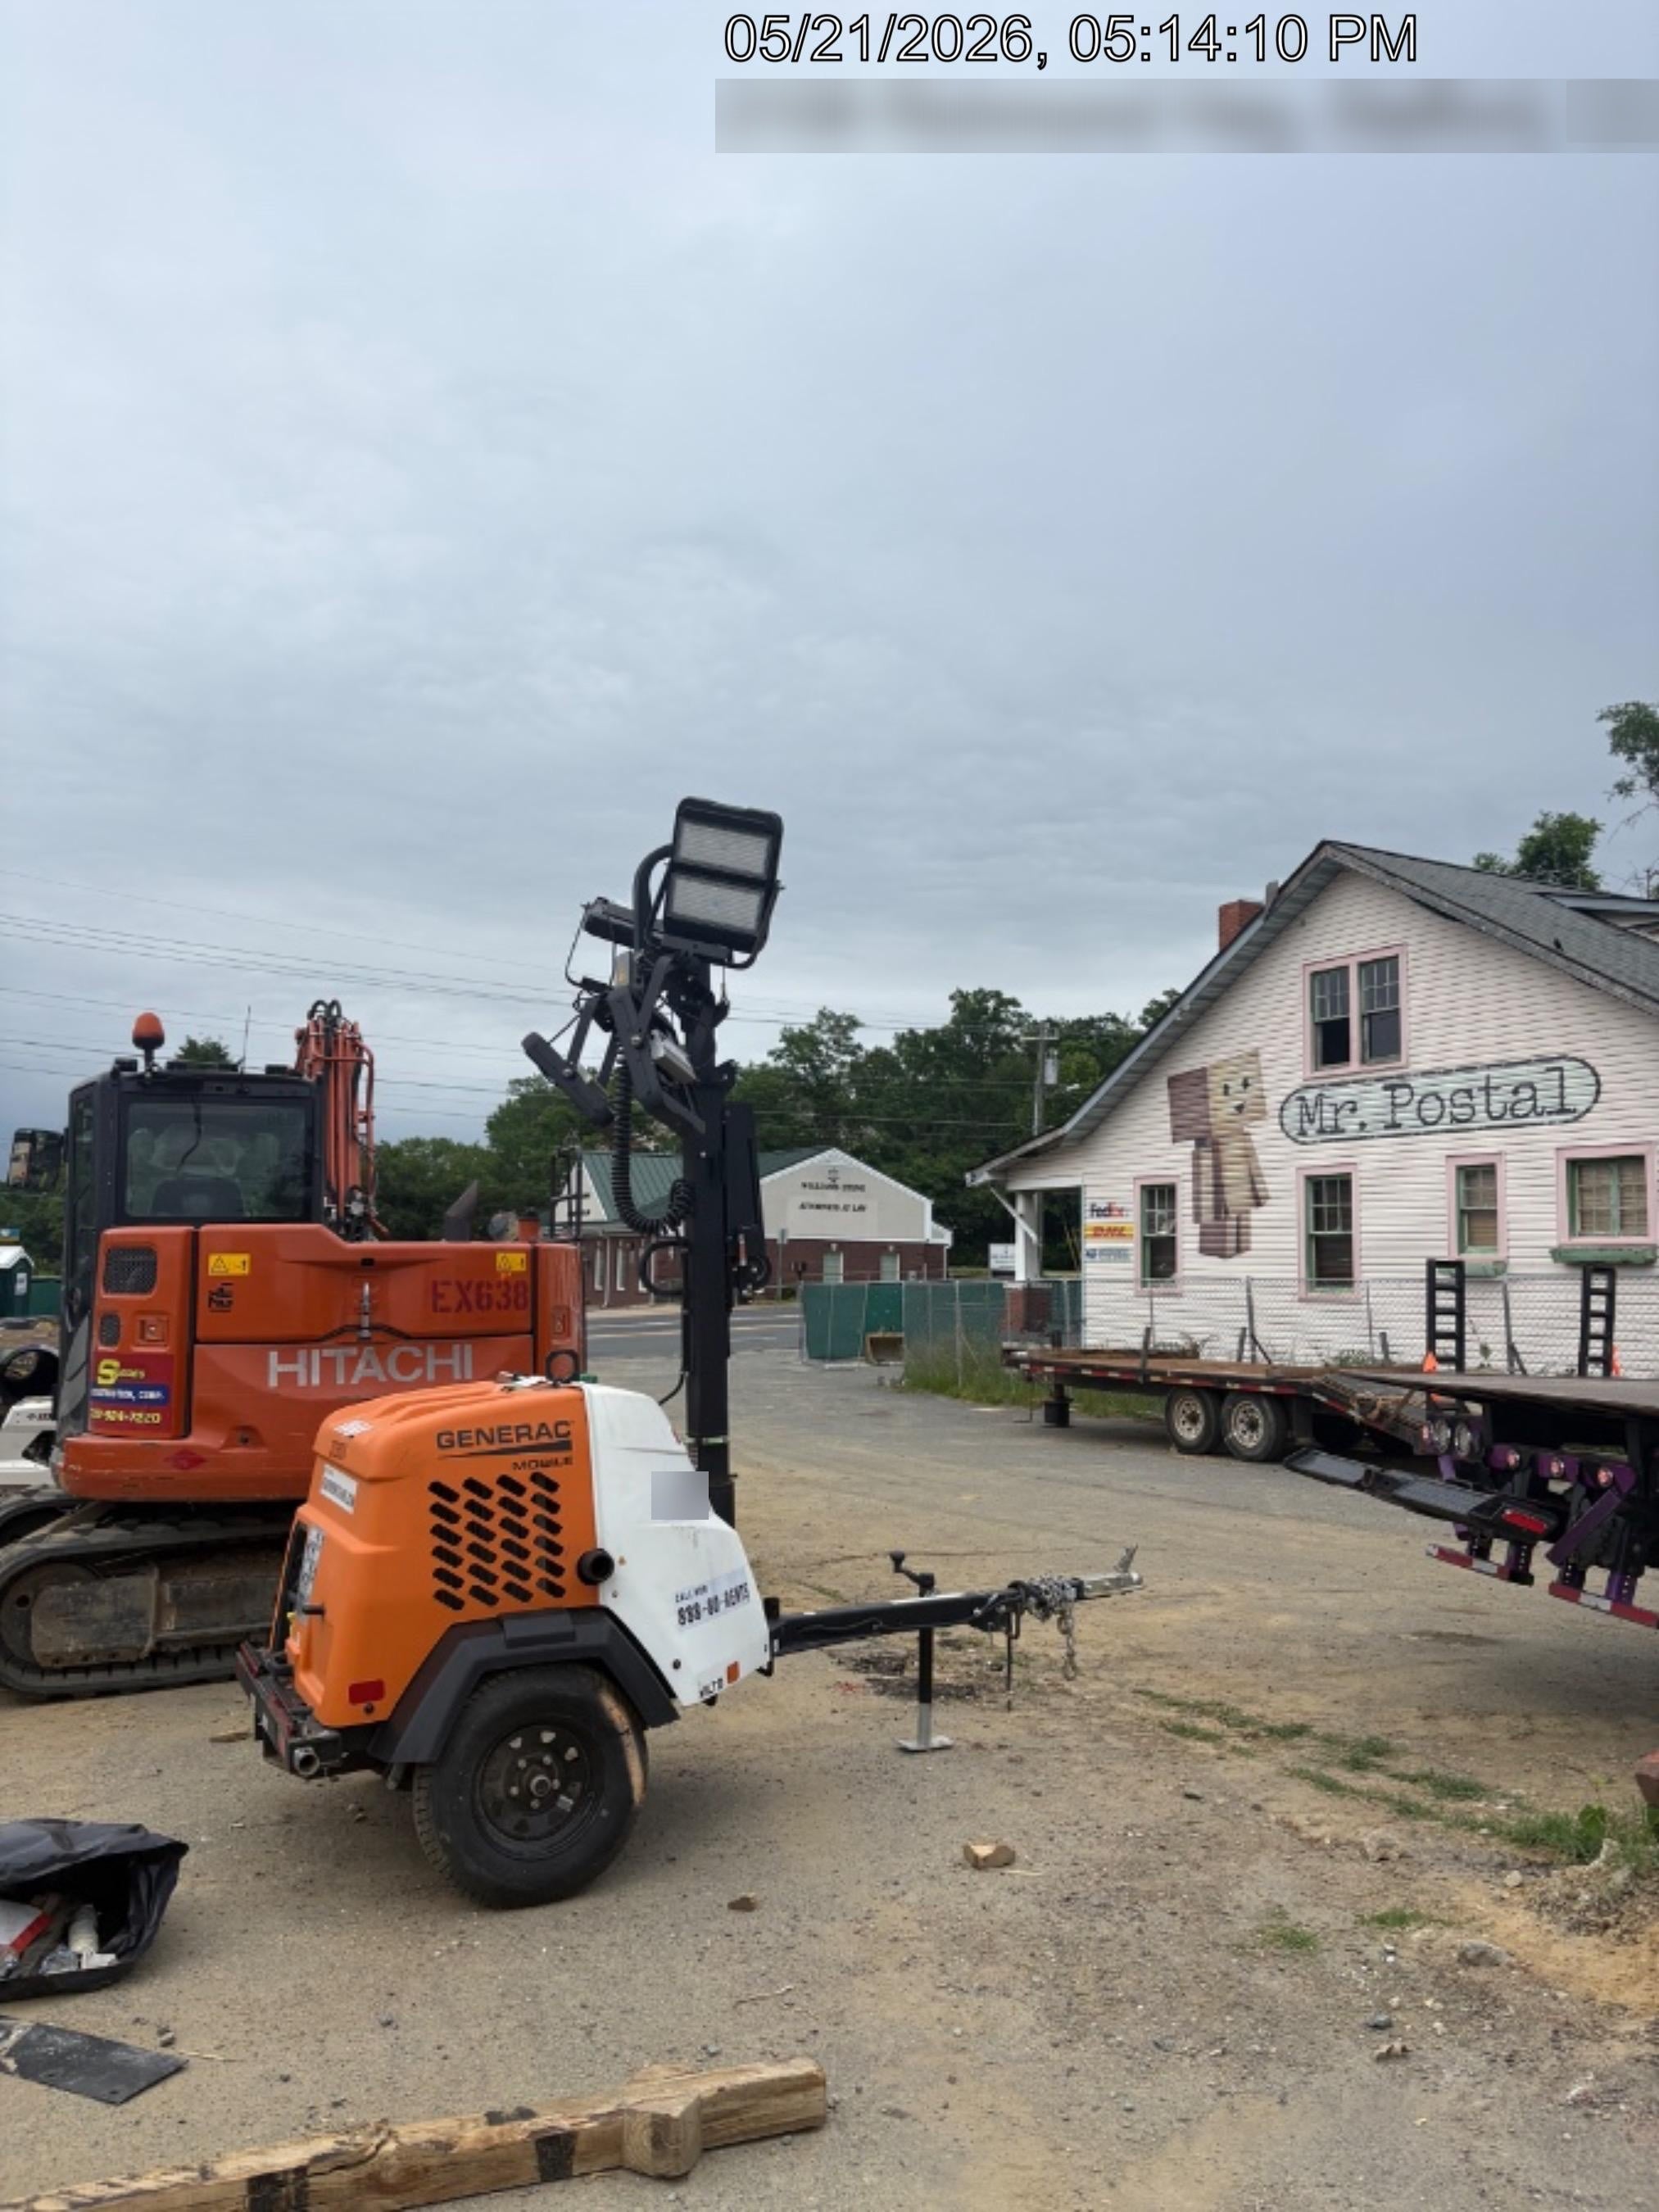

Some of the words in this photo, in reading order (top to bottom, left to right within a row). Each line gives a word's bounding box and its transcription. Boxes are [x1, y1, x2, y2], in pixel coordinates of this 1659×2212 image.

[1294, 1092, 1368, 1136] Mr.
[1381, 1066, 1578, 1130] Postal
[1090, 1202, 1124, 1218] FedEx
[432, 1280, 528, 1312] EX638
[268, 1344, 473, 1388] HITACHI
[437, 1420, 571, 1449] GENERAC
[512, 1457, 573, 1471] MOBILE
